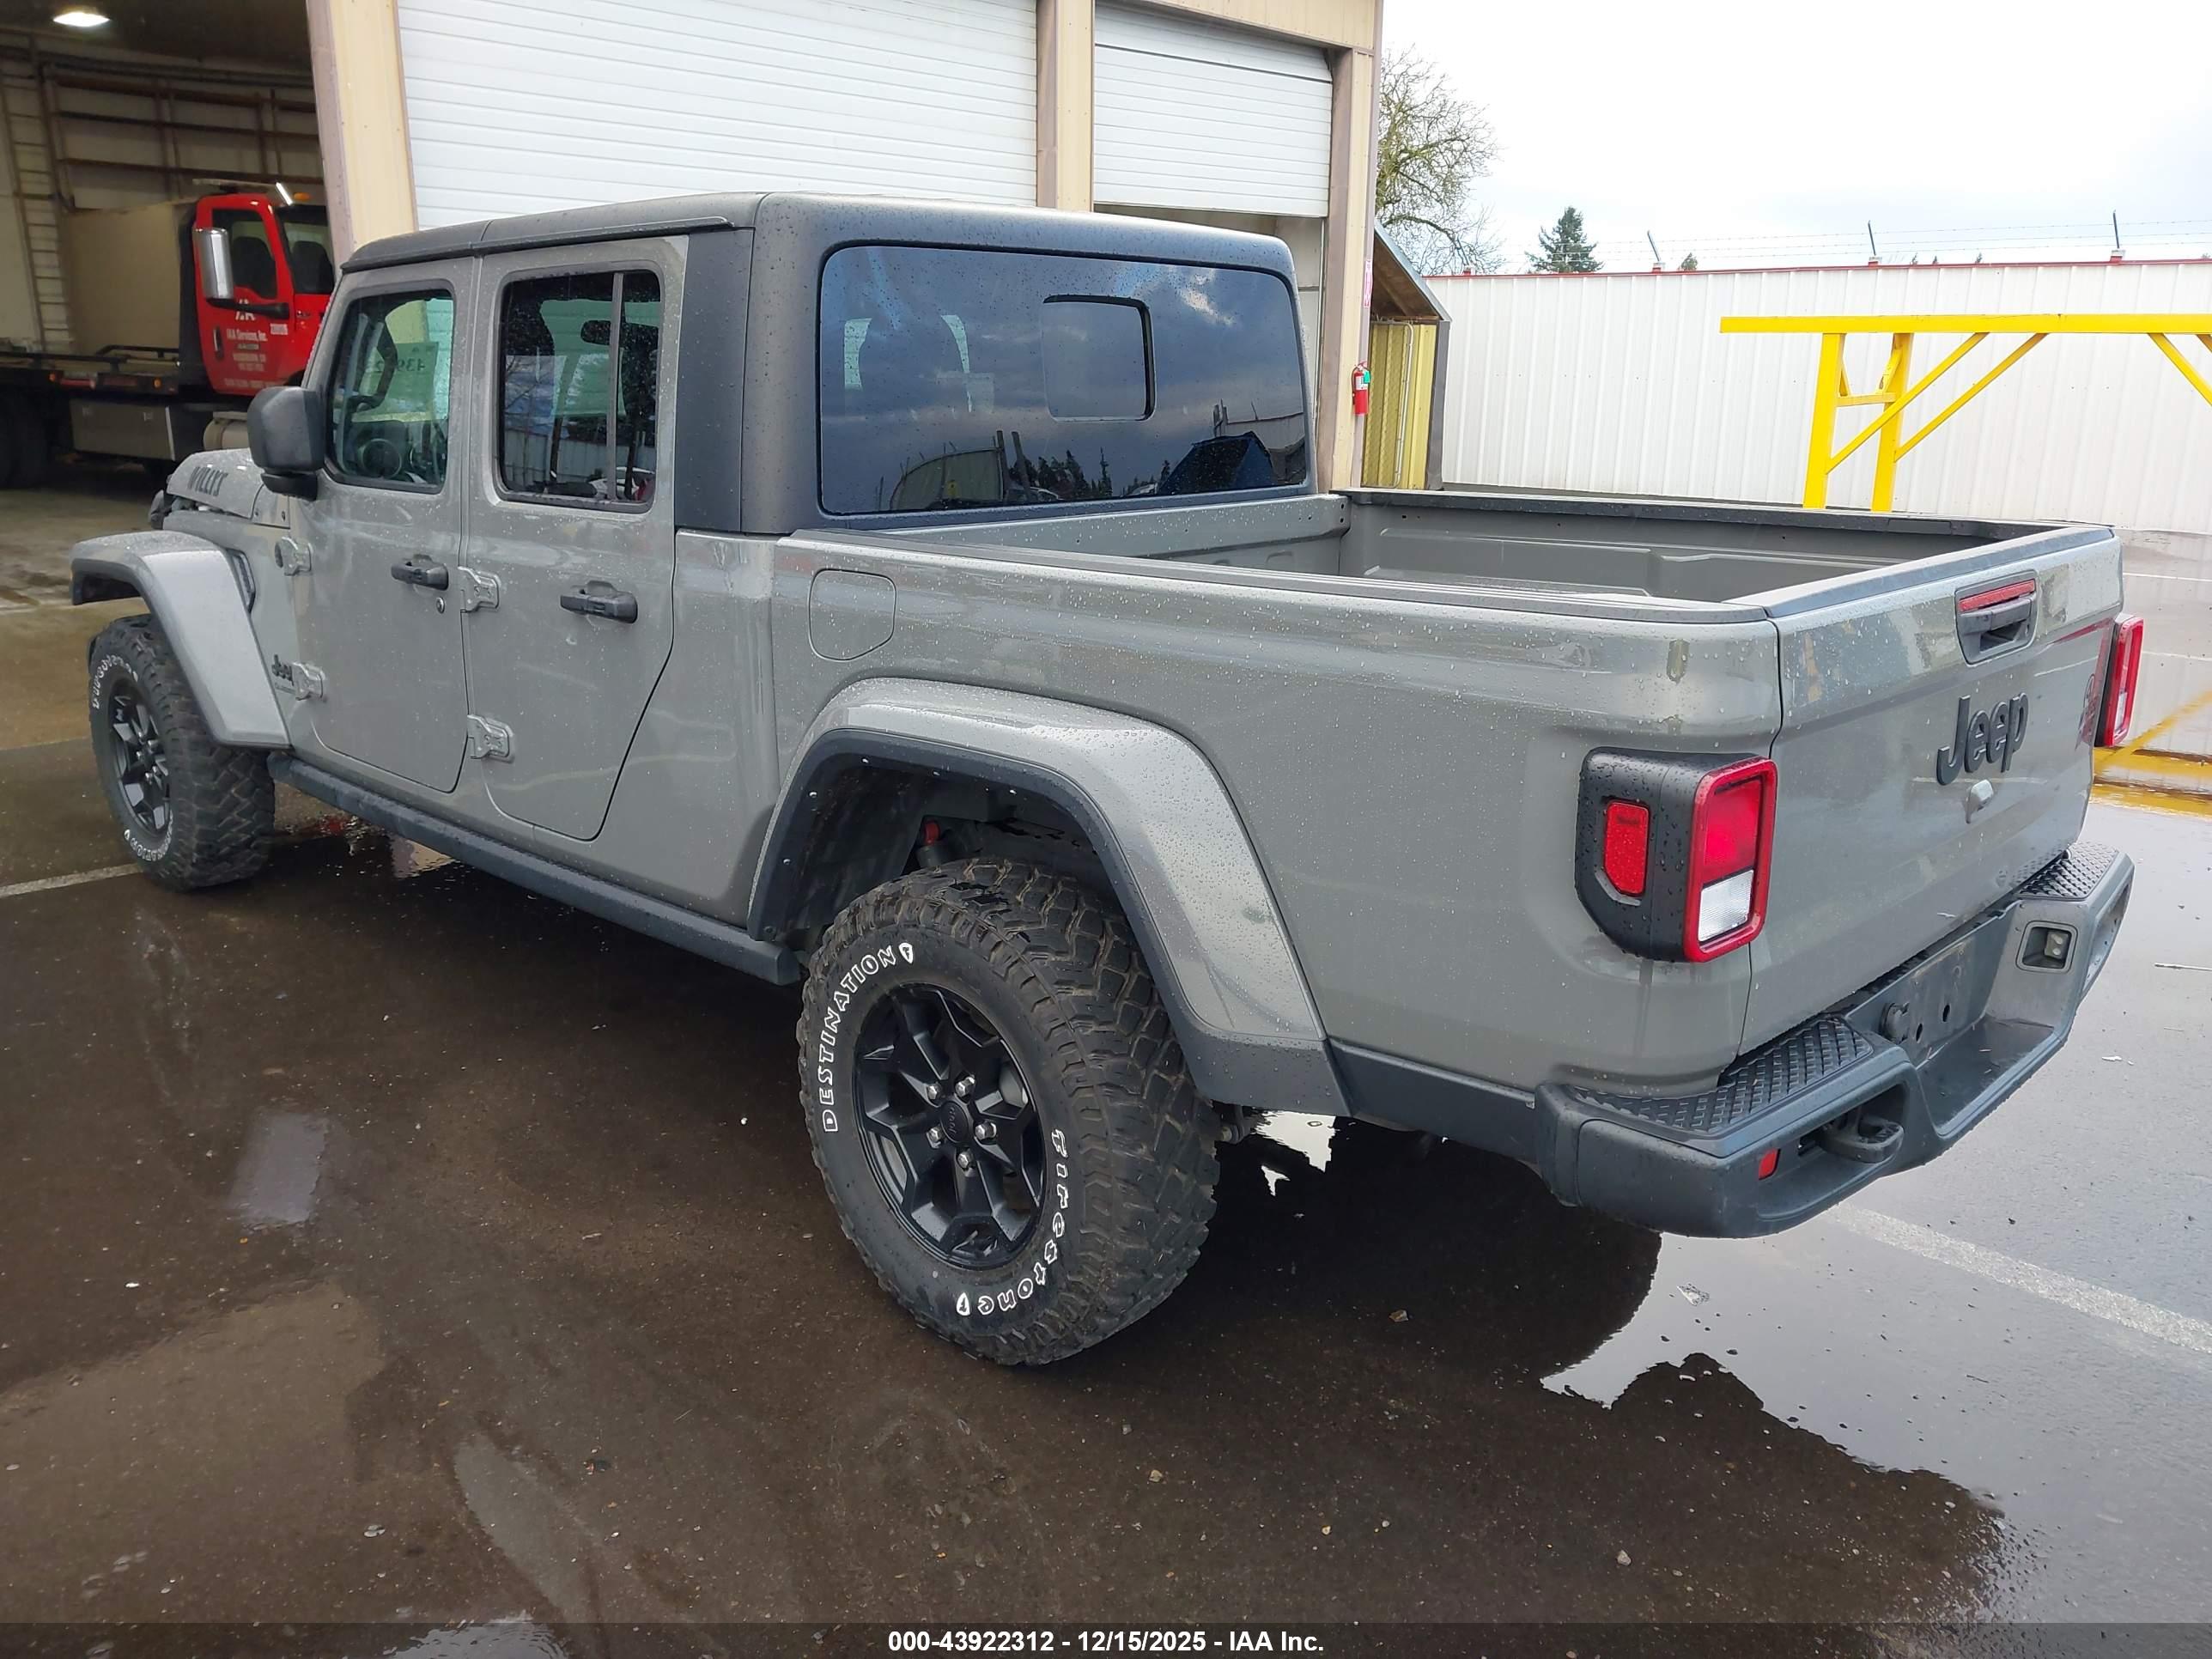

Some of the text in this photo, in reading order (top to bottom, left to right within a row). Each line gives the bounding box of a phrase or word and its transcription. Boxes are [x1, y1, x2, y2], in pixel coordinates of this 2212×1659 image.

[188, 466, 228, 497] WILLYS
[1936, 692, 2029, 786] Jeep
[818, 944, 896, 1132] DESTINATION
